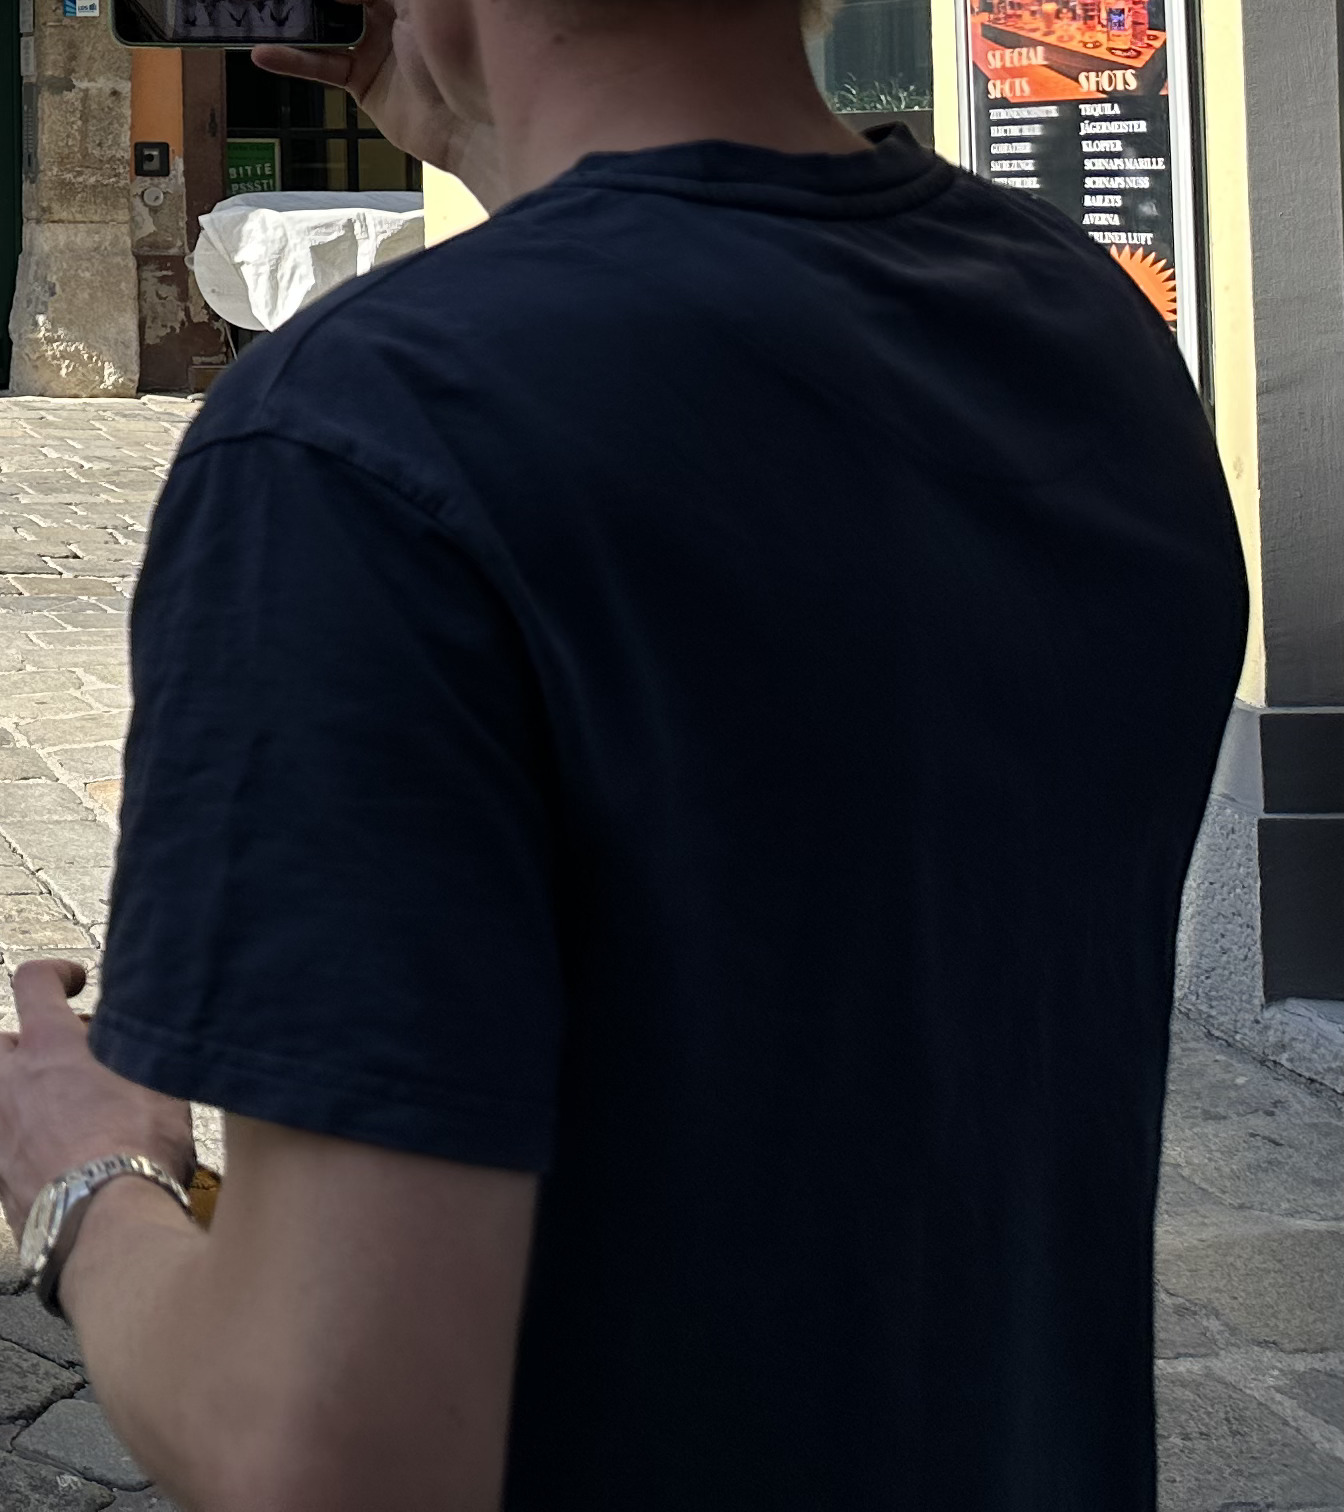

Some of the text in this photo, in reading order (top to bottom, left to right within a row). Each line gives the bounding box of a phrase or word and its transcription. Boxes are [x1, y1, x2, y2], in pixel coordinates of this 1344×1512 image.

[986, 45, 1049, 70] SPECIAL
[987, 77, 1031, 100] SHOTS
[1077, 68, 1138, 92] SHOTS
[1078, 103, 1121, 117] TEQUILA
[1078, 119, 1148, 136] JÄGERMEISTER
[228, 162, 273, 179] BITTE
[1083, 158, 1125, 171] SCHNAPS
[1084, 176, 1125, 189] SCHNAPS
[1082, 213, 1121, 226] AVERNA
